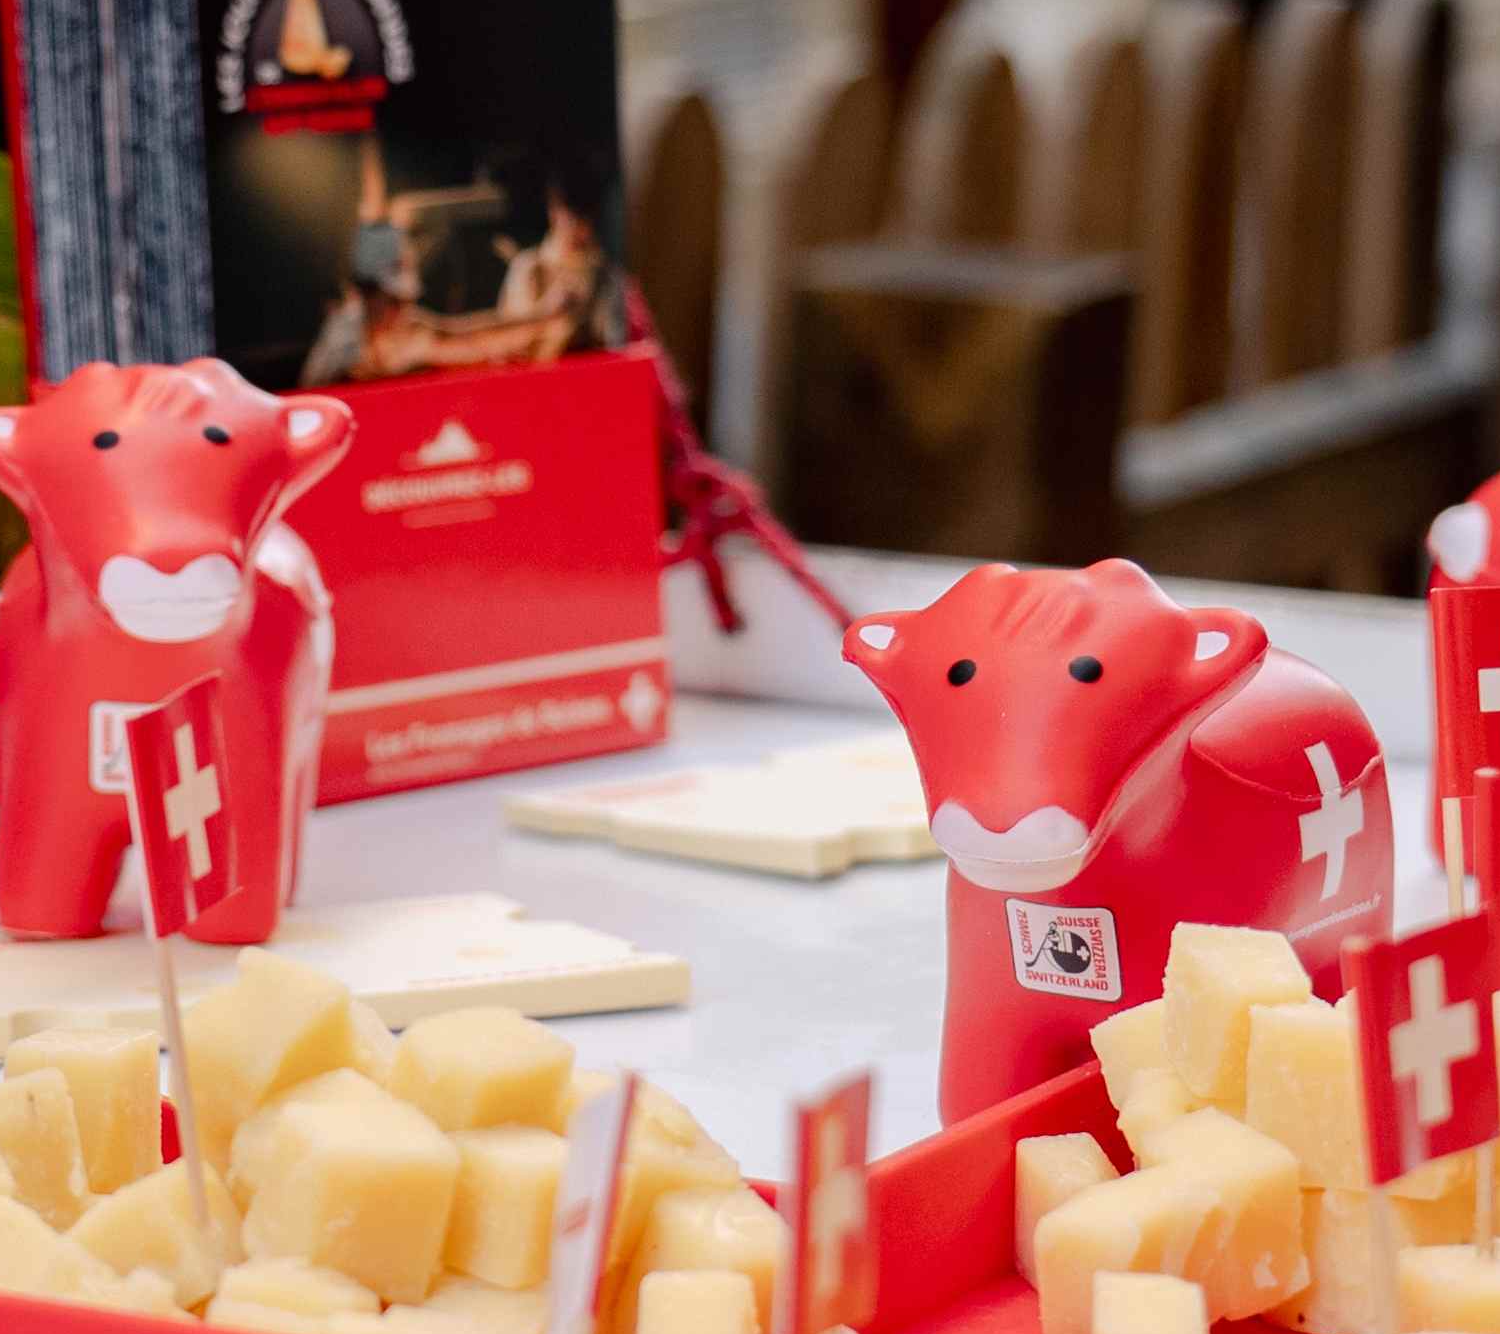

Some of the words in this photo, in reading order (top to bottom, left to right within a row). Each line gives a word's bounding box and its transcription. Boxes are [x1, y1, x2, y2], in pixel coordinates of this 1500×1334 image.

[1015, 909, 1032, 955] SCHWEIZ
[1056, 916, 1100, 928] SUISSE
[1090, 929, 1107, 979] SVIZZERA
[1025, 970, 1108, 991] SWITZERLAND
